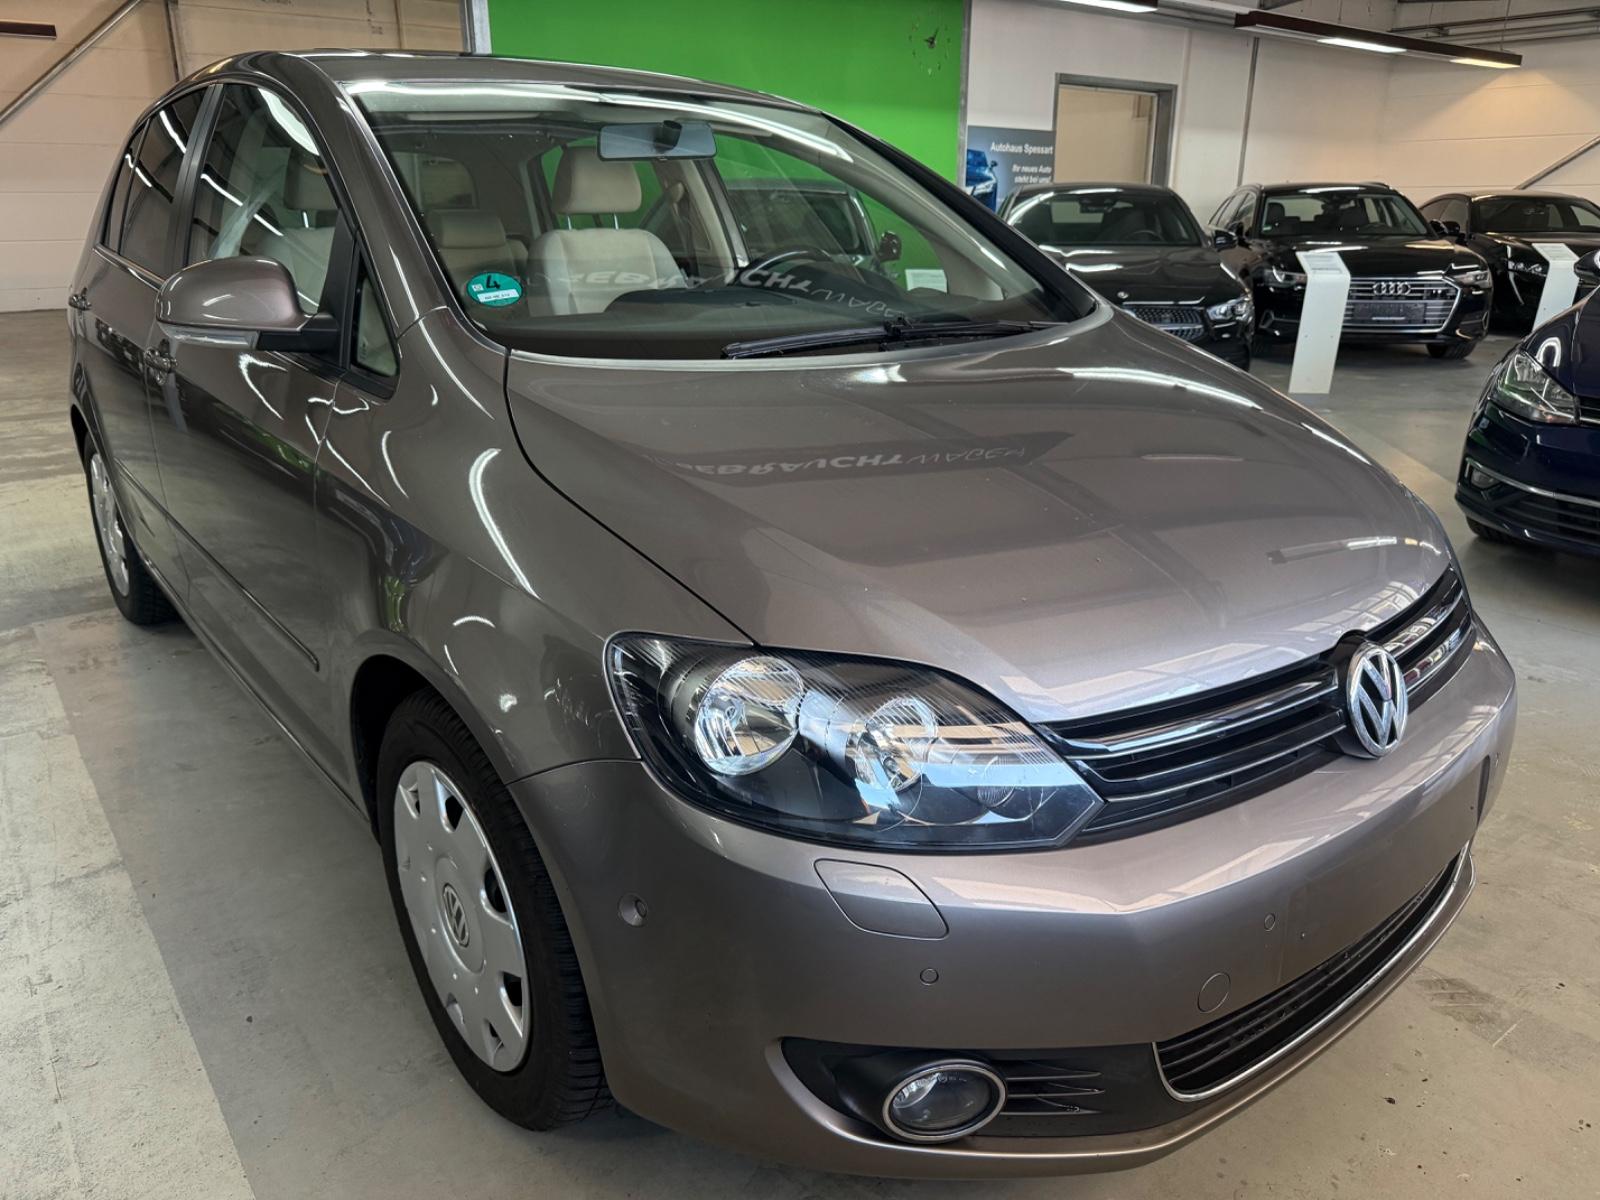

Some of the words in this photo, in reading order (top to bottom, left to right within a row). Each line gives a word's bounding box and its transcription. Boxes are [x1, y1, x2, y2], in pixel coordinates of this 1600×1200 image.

[991, 142, 1023, 153] Autohaus
[1024, 143, 1053, 155] Spessart
[486, 274, 501, 289] 4
